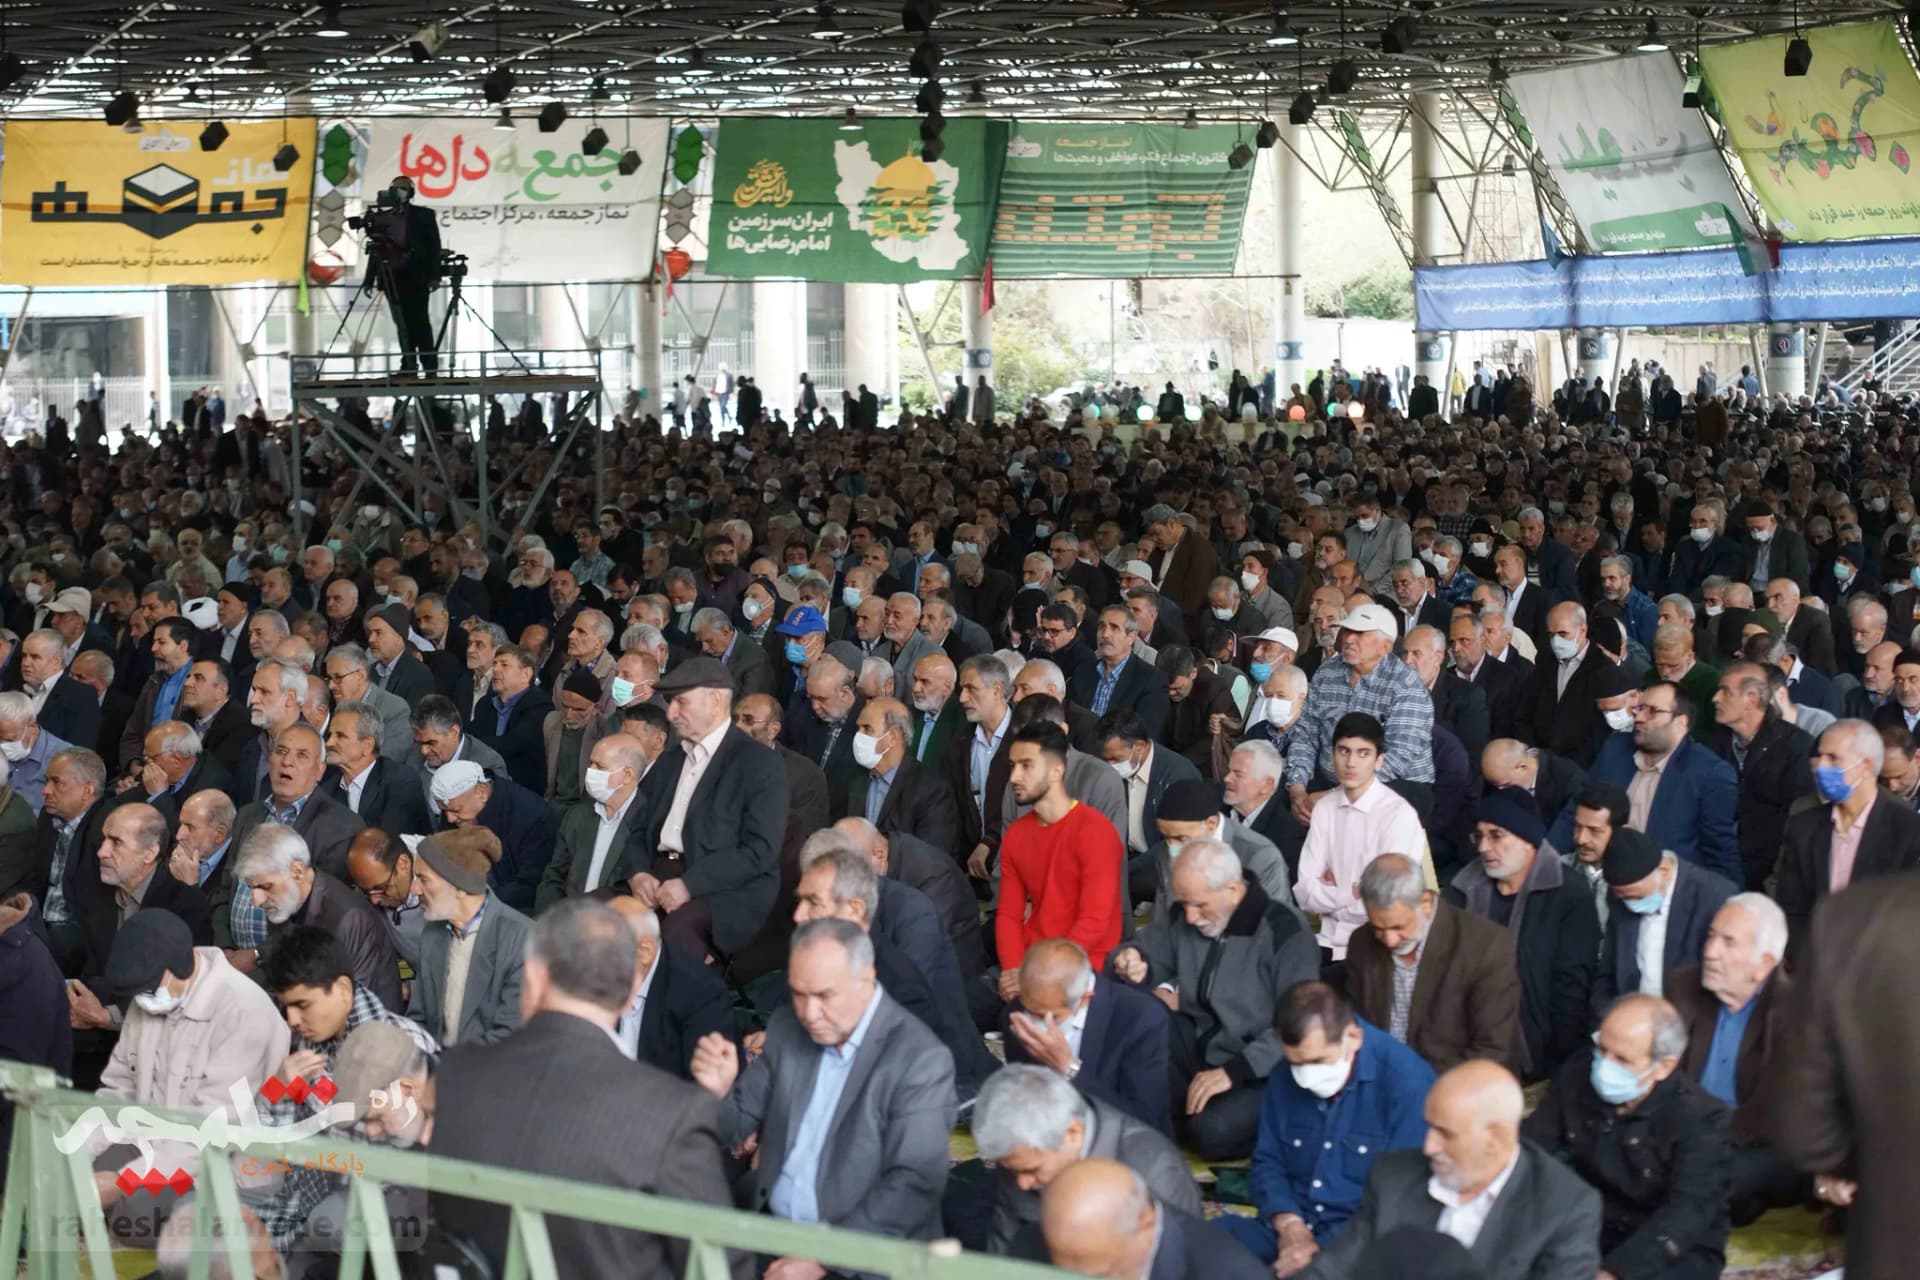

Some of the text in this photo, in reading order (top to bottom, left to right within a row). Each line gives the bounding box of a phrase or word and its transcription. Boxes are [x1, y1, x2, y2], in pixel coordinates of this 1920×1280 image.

[212, 158, 288, 185] ماز
[440, 205, 498, 227] اجتماع
[499, 203, 536, 225] مرکز
[595, 203, 630, 225] نماز
[728, 211, 834, 232] ایران سرزمین
[794, 234, 831, 256] امام
